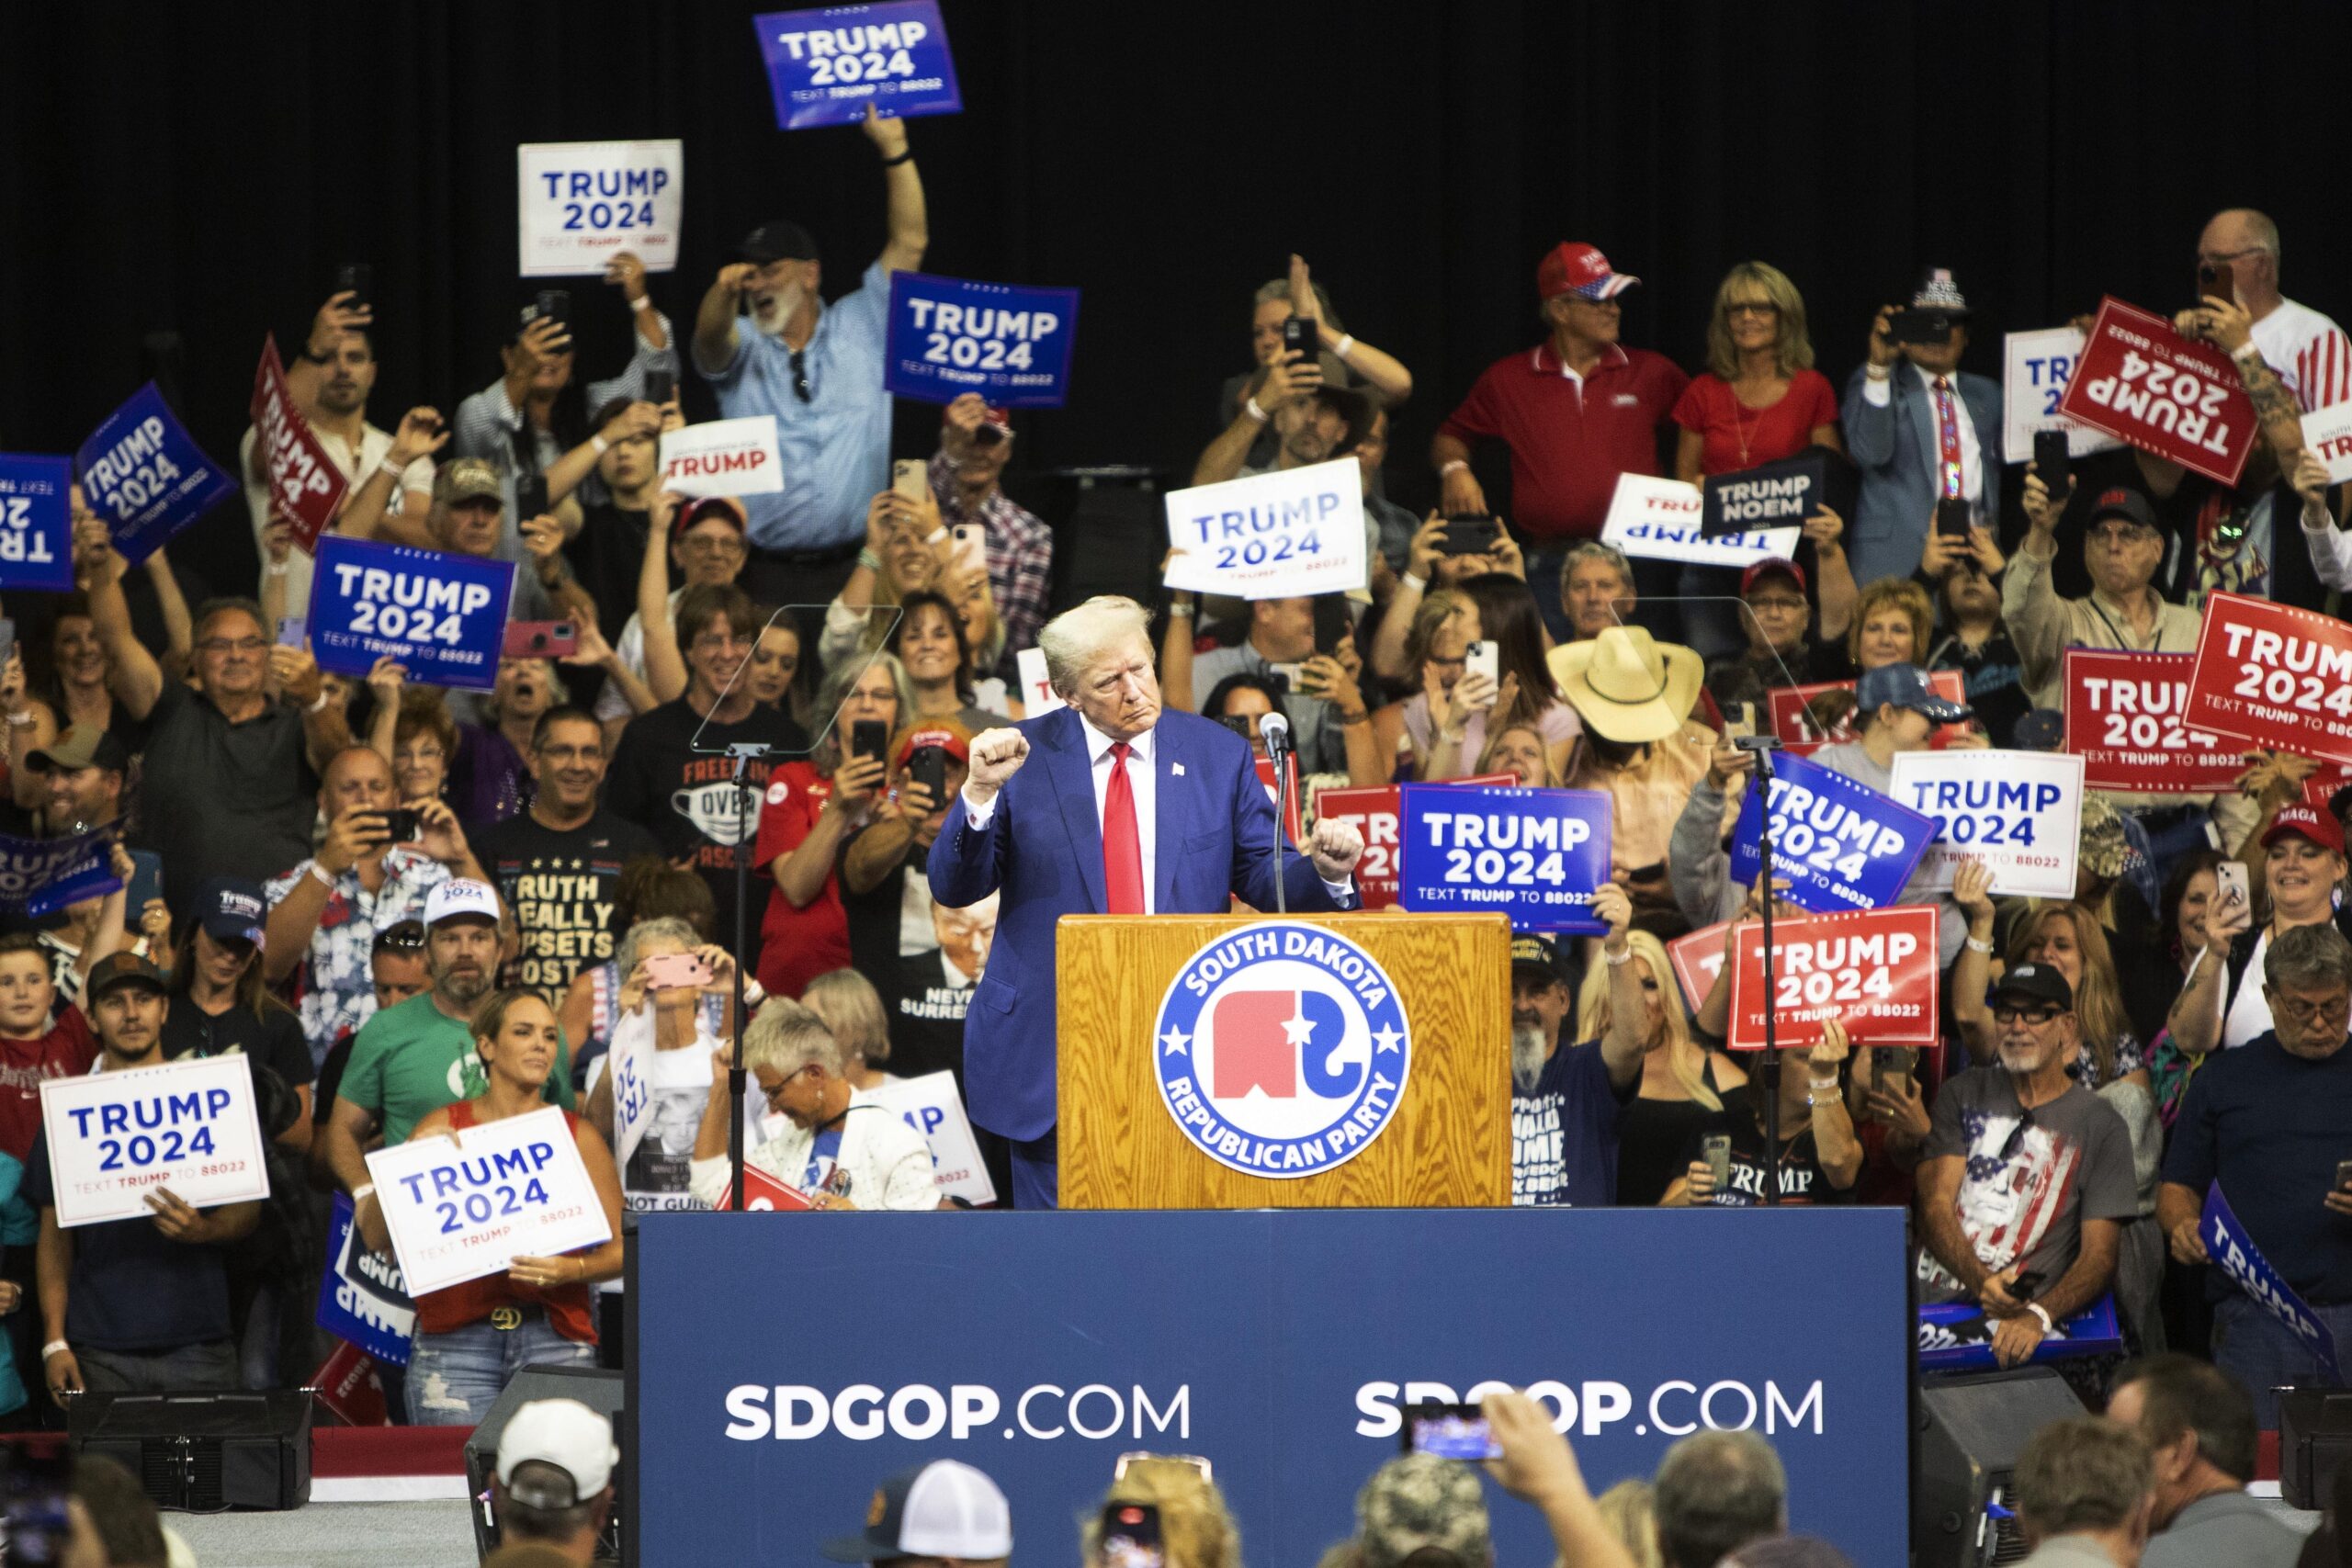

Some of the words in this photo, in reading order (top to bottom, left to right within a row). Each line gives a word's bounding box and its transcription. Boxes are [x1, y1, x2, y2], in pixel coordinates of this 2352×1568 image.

[778, 21, 927, 60] TRUMP
[808, 49, 916, 86] 2024
[541, 167, 669, 198] TRUMP
[563, 199, 655, 230] 2024
[907, 298, 1058, 342] TRUMP
[924, 333, 1033, 370] 2024
[2026, 354, 2080, 386] TR
[2175, 353, 2220, 381] TRUMP
[938, 367, 987, 384] TRUMP
[2120, 350, 2229, 416] 2024
[2087, 375, 2229, 457] TRUMP
[85, 416, 164, 502] TRUMP
[668, 450, 766, 477] TRUMP
[106, 452, 181, 521] 2024
[1646, 496, 1702, 513] TRU
[1718, 475, 1811, 503] TRUMP
[1192, 491, 1340, 544] TRUMP
[1723, 498, 1803, 522] NOEM
[1216, 528, 1322, 570] 2024
[334, 562, 491, 615] TRUMP
[349, 600, 462, 645] 2024
[322, 630, 358, 648] TEXT
[362, 637, 413, 658] TRUMP
[418, 646, 436, 660] TO
[2224, 622, 2352, 683] TRUM
[2234, 663, 2352, 718] 2024
[2205, 693, 2242, 713] TEXT
[2247, 702, 2299, 726] TRUMP
[2304, 715, 2323, 731] TO
[2080, 750, 2114, 763] TEXT
[2120, 751, 2169, 766] TRUMP
[2175, 752, 2193, 767] TO
[1912, 780, 2061, 812] TRUMP
[1423, 812, 1590, 852] TRUMP
[1766, 777, 1905, 858] TRUMP
[1930, 814, 2035, 846] 2024
[2278, 807, 2318, 825] MAGA
[1445, 849, 1566, 886] 2024
[1760, 814, 1868, 884] 2024
[1942, 852, 1985, 863] TRUMP
[2016, 854, 2060, 868] 88022
[1770, 852, 1809, 877] RUMP
[1812, 871, 1829, 888] TO
[1418, 886, 1456, 900] TEXT
[1462, 888, 1515, 903] TRUMP
[1521, 891, 1541, 904] TO
[1544, 891, 1592, 905] 88022
[518, 900, 615, 930] EALLY
[521, 931, 614, 959] PSETS
[1754, 932, 1917, 977] TRUMP
[1185, 931, 1278, 998] SOUTH
[1284, 931, 1388, 1011] DAKOTA
[1776, 966, 1893, 1008] 2024
[900, 998, 966, 1020] SURRE
[926, 987, 975, 1004] NEVE
[1792, 1005, 1843, 1022] TRUMP
[1848, 1004, 1867, 1017] TO
[1871, 1004, 1921, 1017] 88022
[68, 1089, 231, 1138] TRUMP
[1167, 1076, 1327, 1169] REPUBLICAN
[1326, 1071, 1396, 1154] PARTY
[98, 1126, 215, 1171] 2024
[74, 1179, 111, 1195] TEXT
[118, 1172, 171, 1190] TRUMP
[175, 1168, 195, 1179] TO
[201, 1161, 246, 1177] 88022
[400, 1142, 554, 1204] TRUMP
[435, 1178, 549, 1235] 2024
[625, 1196, 658, 1211] NOT
[665, 1197, 708, 1211] GUIL
[461, 1226, 511, 1249] TRUMP
[539, 1206, 583, 1225] 88022
[2215, 1215, 2319, 1339] TRUMP
[724, 1383, 1191, 1441] SDGOP.COM
[1354, 1380, 1823, 1438] SOP.COM
